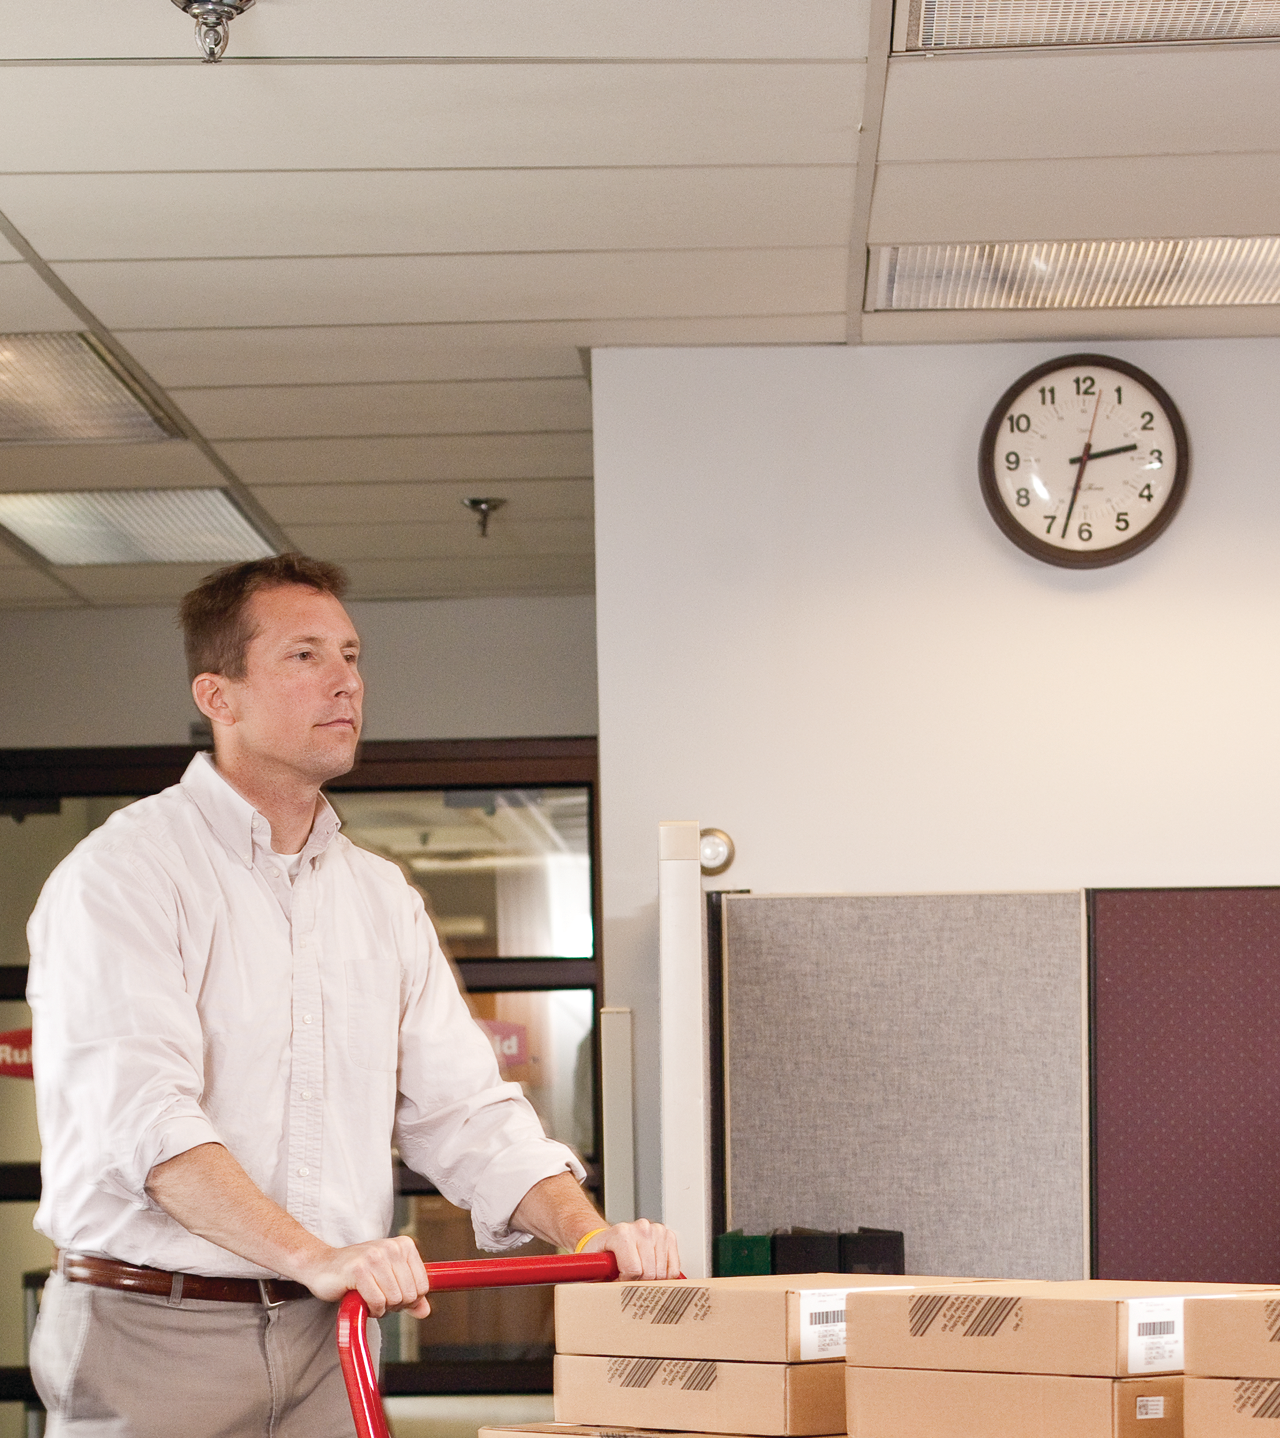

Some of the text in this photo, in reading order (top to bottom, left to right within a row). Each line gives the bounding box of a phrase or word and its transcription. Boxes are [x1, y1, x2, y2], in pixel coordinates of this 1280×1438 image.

[1073, 376, 1096, 395] 12
[1115, 386, 1122, 404] 1
[1039, 386, 1055, 405] 11
[1007, 413, 1031, 433] 10
[1140, 411, 1154, 431] 2
[1005, 451, 1020, 471] 9
[1149, 449, 1163, 469] 3
[1016, 487, 1030, 507] 8
[1138, 483, 1154, 502] 4
[1043, 515, 1056, 534] 7
[1115, 512, 1129, 531] 5
[1078, 522, 1093, 541] 6
